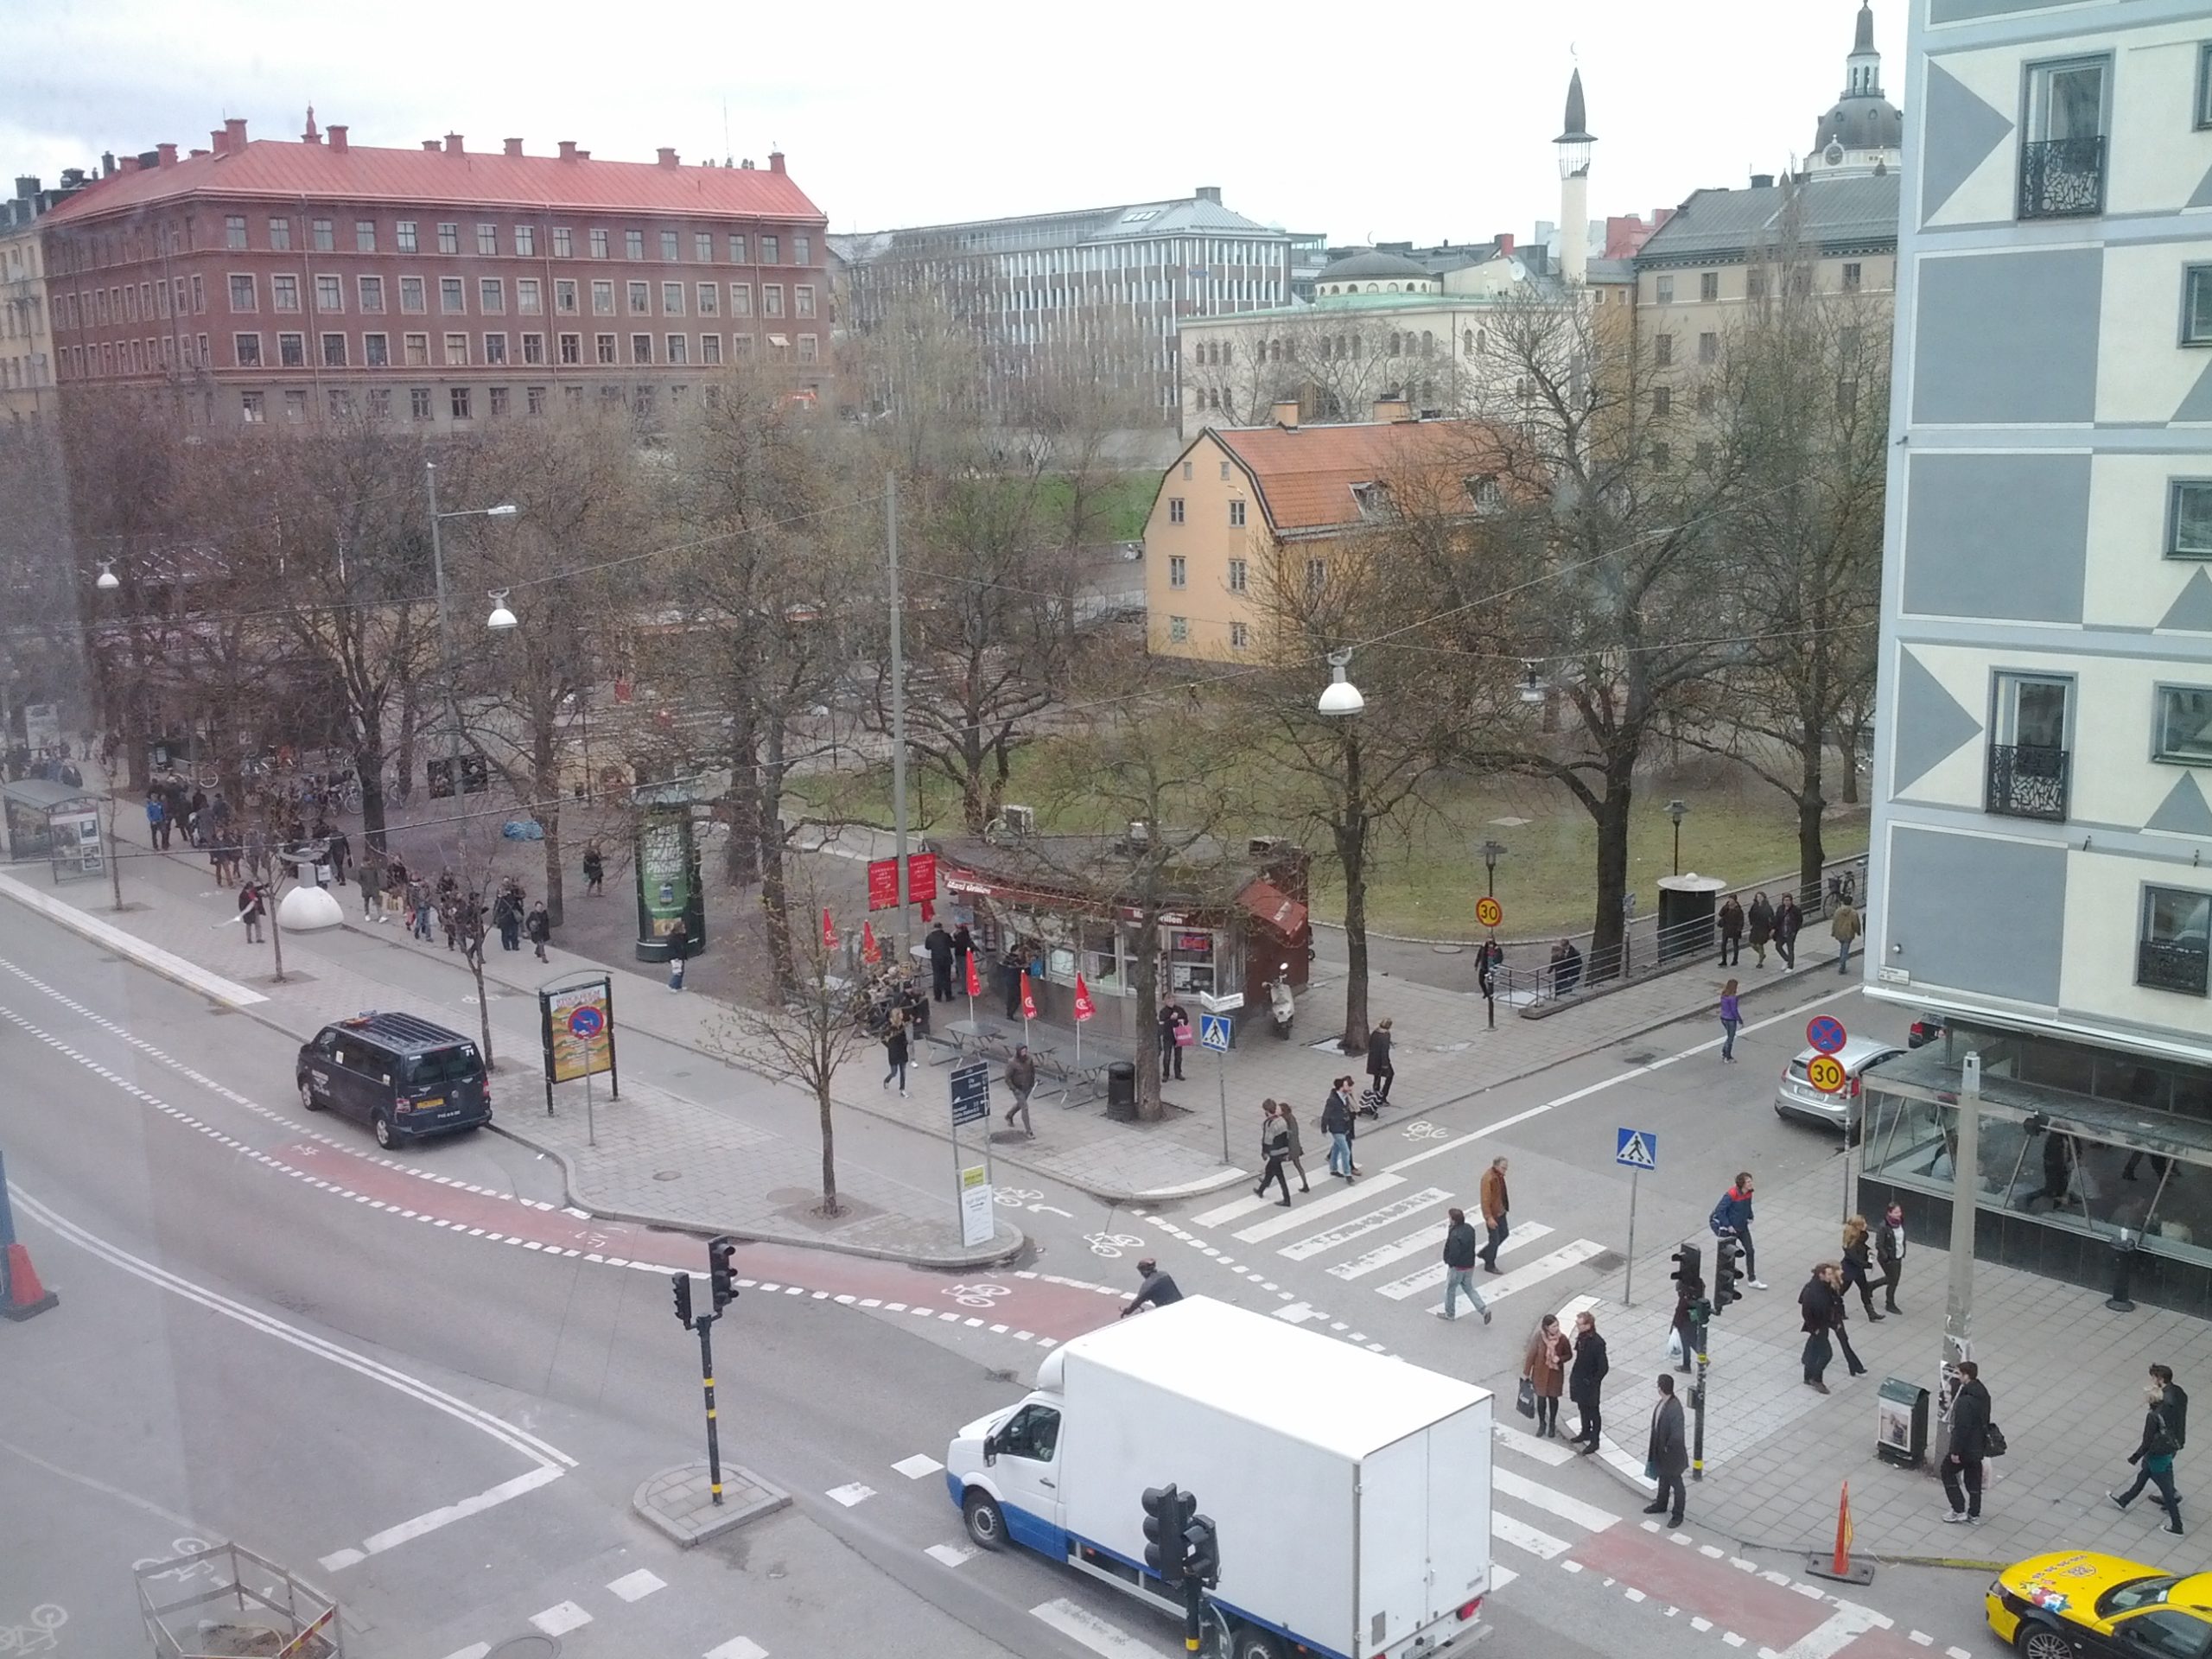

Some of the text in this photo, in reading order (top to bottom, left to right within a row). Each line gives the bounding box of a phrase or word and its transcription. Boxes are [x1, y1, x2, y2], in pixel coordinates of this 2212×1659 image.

[1160, 914, 1183, 925] rillen
[1480, 904, 1498, 920] 30
[1814, 1065, 1839, 1084] 30
